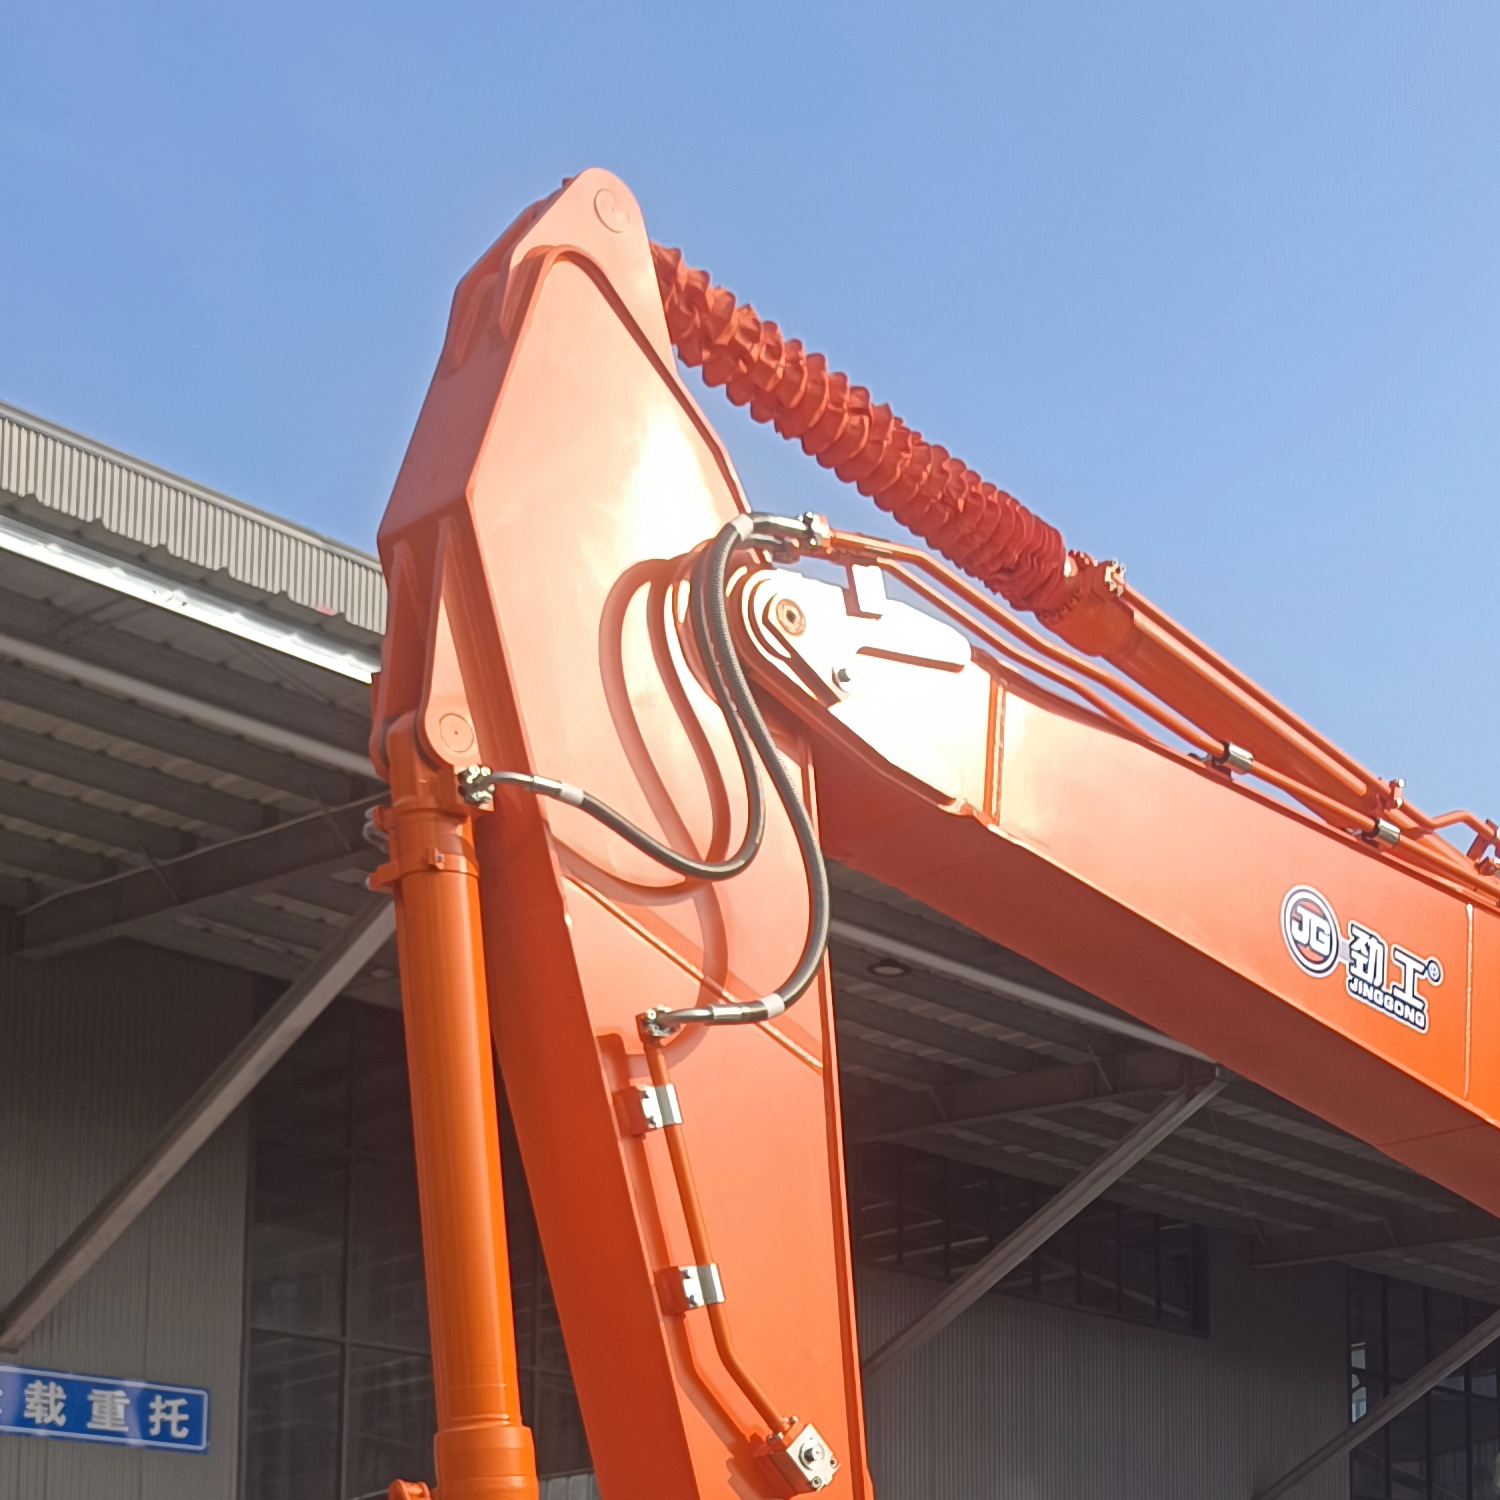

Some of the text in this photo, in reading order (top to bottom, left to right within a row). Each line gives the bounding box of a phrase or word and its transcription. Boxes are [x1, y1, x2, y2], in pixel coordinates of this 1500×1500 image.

[1291, 904, 1332, 957] JG
[1349, 977, 1427, 1031] JINGGONG
[0, 1380, 189, 1438] 载重托
